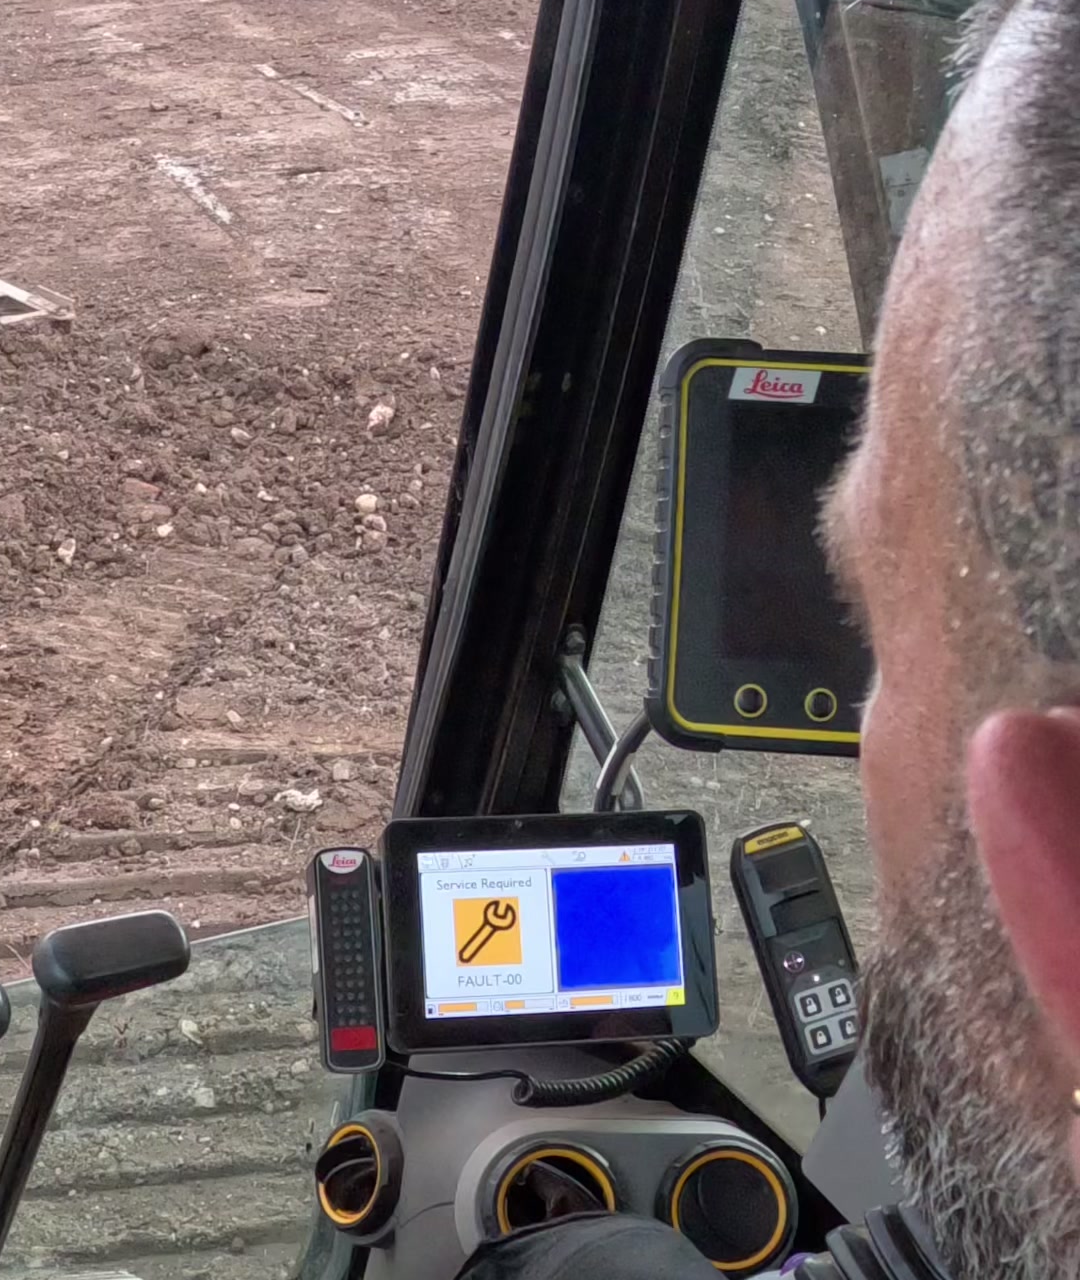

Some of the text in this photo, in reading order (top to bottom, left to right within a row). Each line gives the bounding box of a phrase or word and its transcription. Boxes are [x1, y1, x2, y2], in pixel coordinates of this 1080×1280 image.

[744, 370, 804, 399] Leica
[328, 854, 357, 868] Leica
[436, 876, 532, 892] Service Required
[457, 973, 522, 988] FAULT-00
